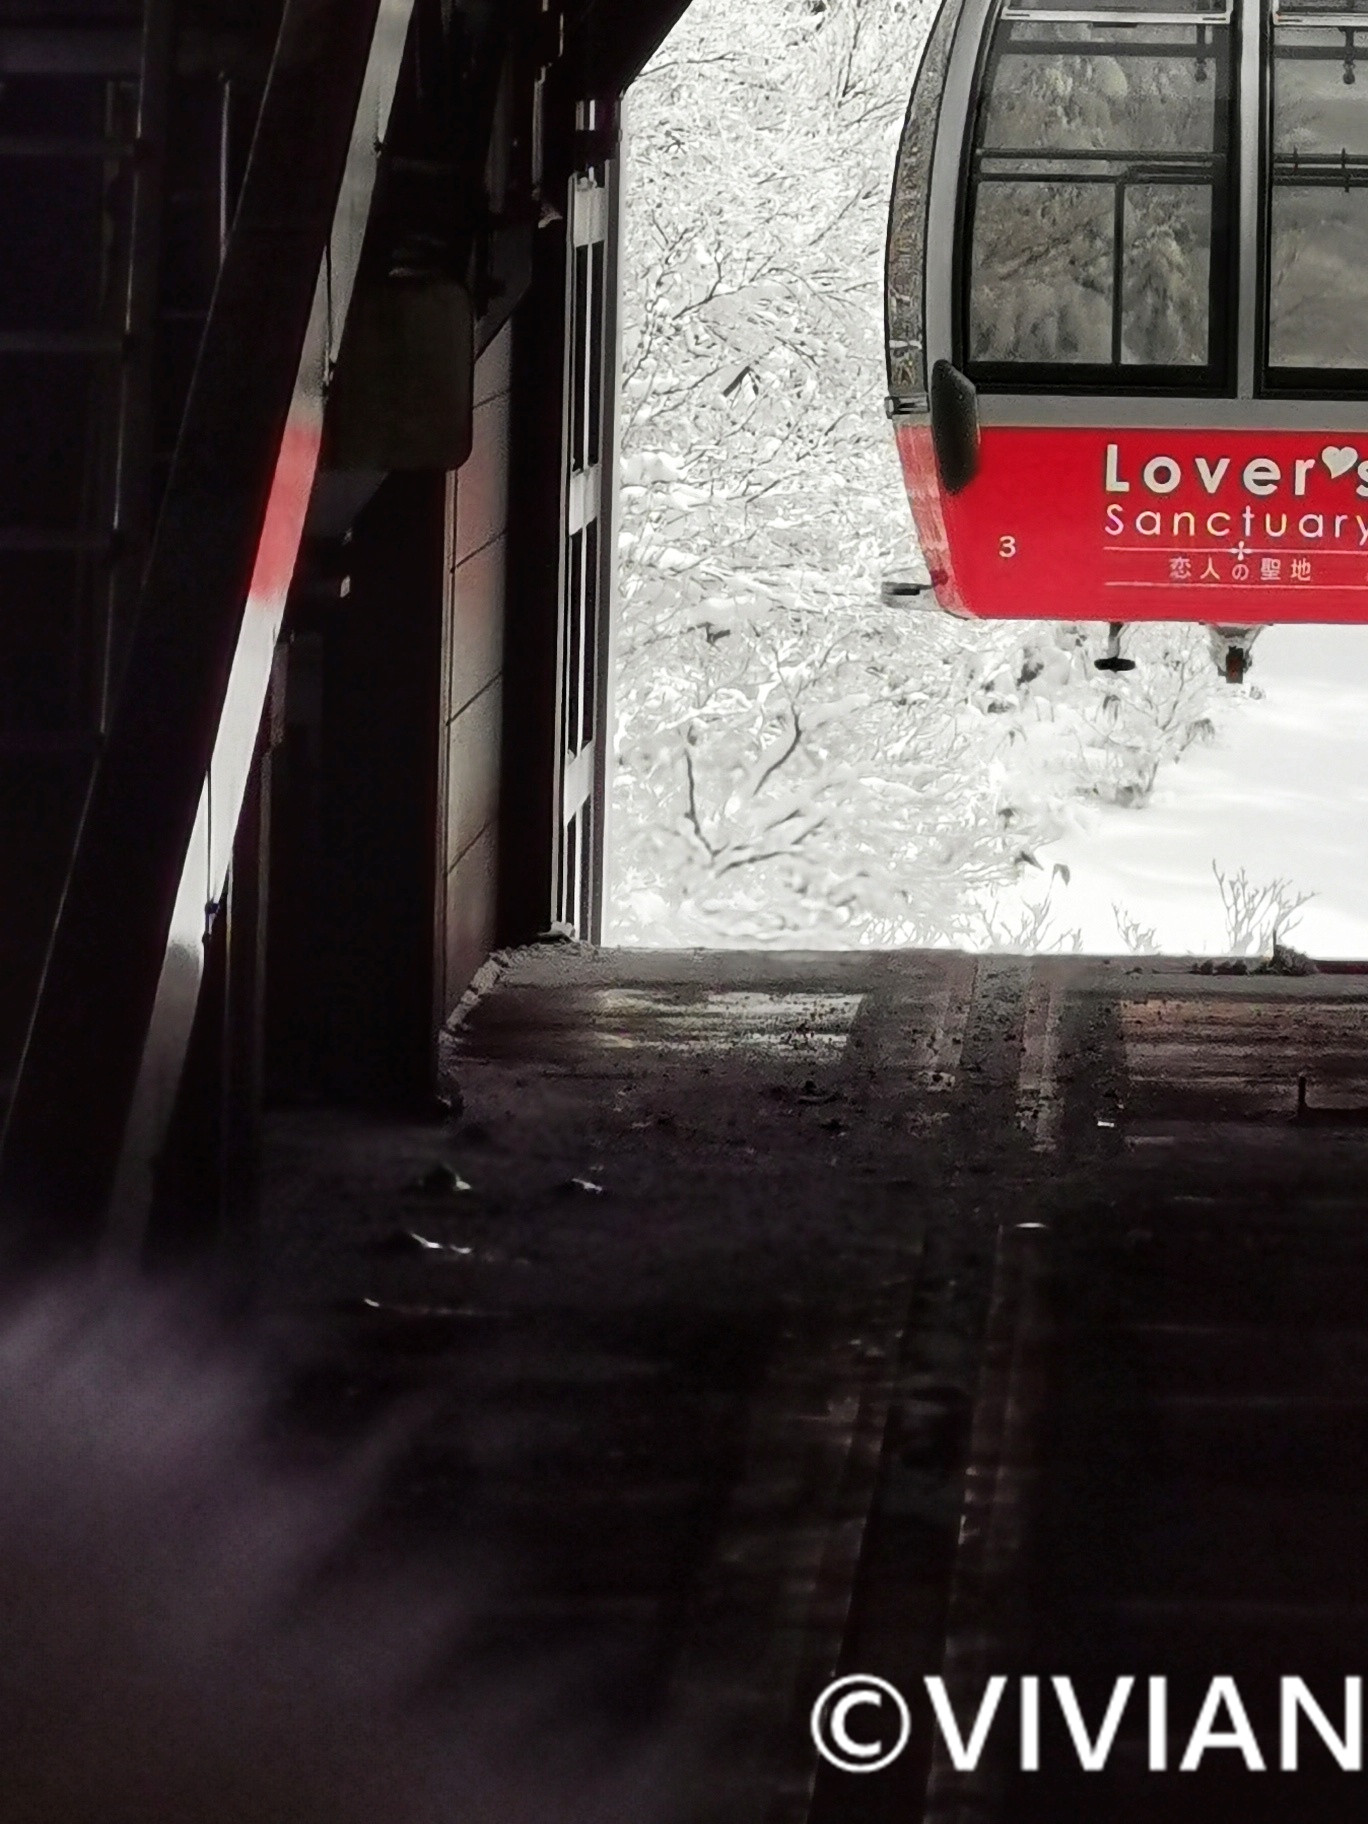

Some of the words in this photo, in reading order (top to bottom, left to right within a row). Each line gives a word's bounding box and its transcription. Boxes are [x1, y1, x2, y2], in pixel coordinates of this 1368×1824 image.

[998, 536, 1017, 559] 3
[1168, 557, 1312, 582] 恋人の聖地
